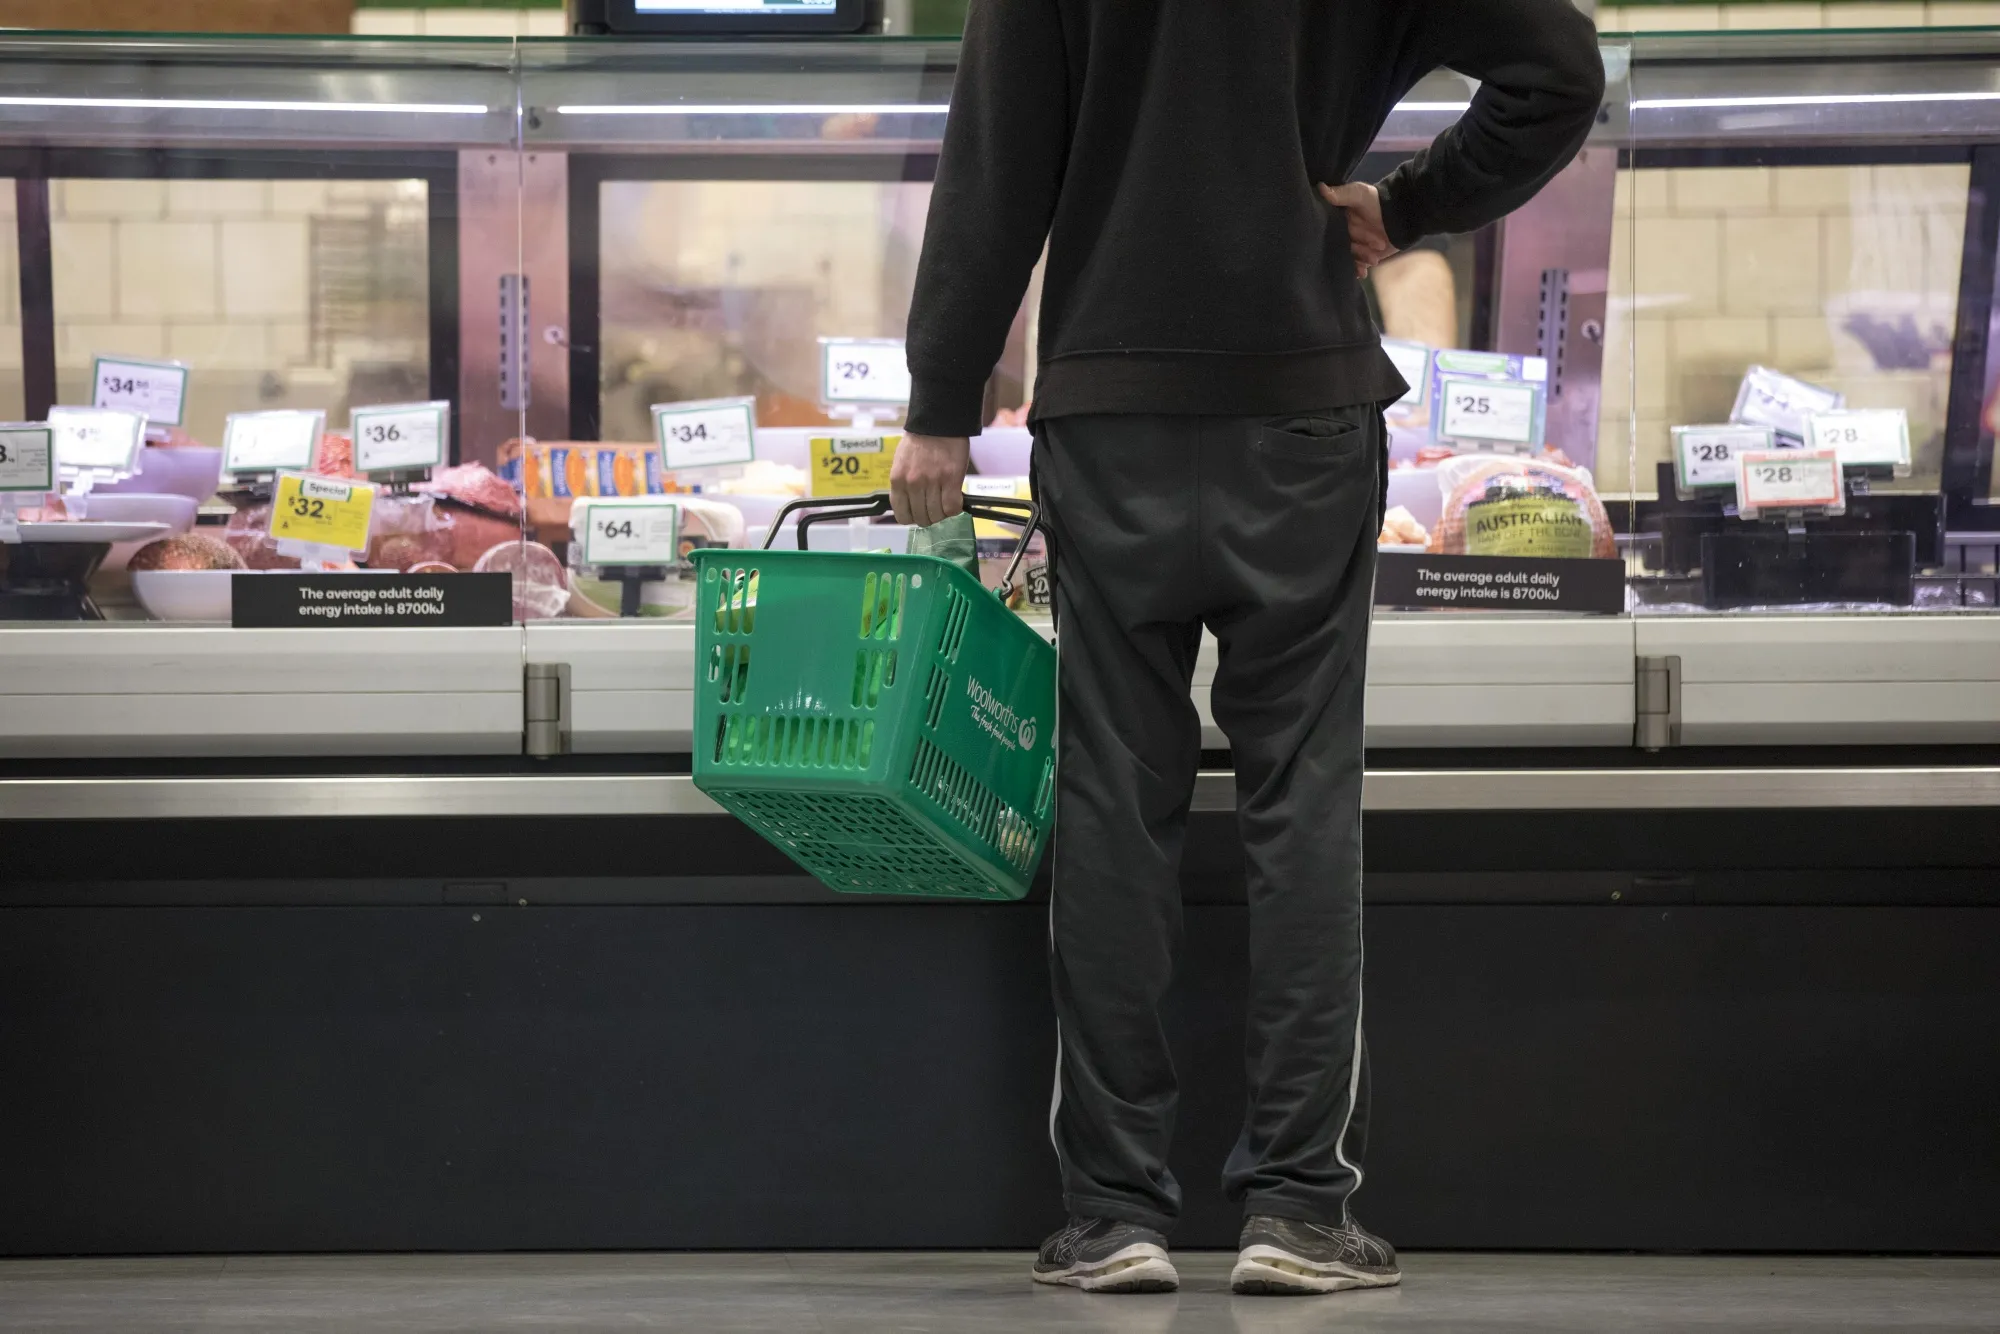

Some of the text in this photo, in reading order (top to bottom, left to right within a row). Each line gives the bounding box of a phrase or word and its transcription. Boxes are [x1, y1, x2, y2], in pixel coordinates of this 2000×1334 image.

[836, 361, 869, 380] $29
[1455, 396, 1490, 414] $25
[365, 424, 400, 443] $36
[671, 423, 708, 443] $34
[839, 439, 878, 449] Special
[1692, 444, 1729, 461] $28
[822, 456, 860, 475] $20
[1755, 466, 1793, 483] $28
[309, 482, 347, 495] Special
[288, 496, 324, 518] $32
[597, 520, 633, 538] $64
[1476, 511, 1582, 534] AUSTRALIAN
[1417, 569, 1560, 587] The average adult daily
[299, 586, 444, 602] The average adult daily
[1416, 586, 1560, 600] energy intake is 8700kJ
[299, 602, 445, 618] energy intake is 8700kJ
[967, 675, 1019, 734] Woolworths
[971, 704, 1016, 752] The fresh food people
